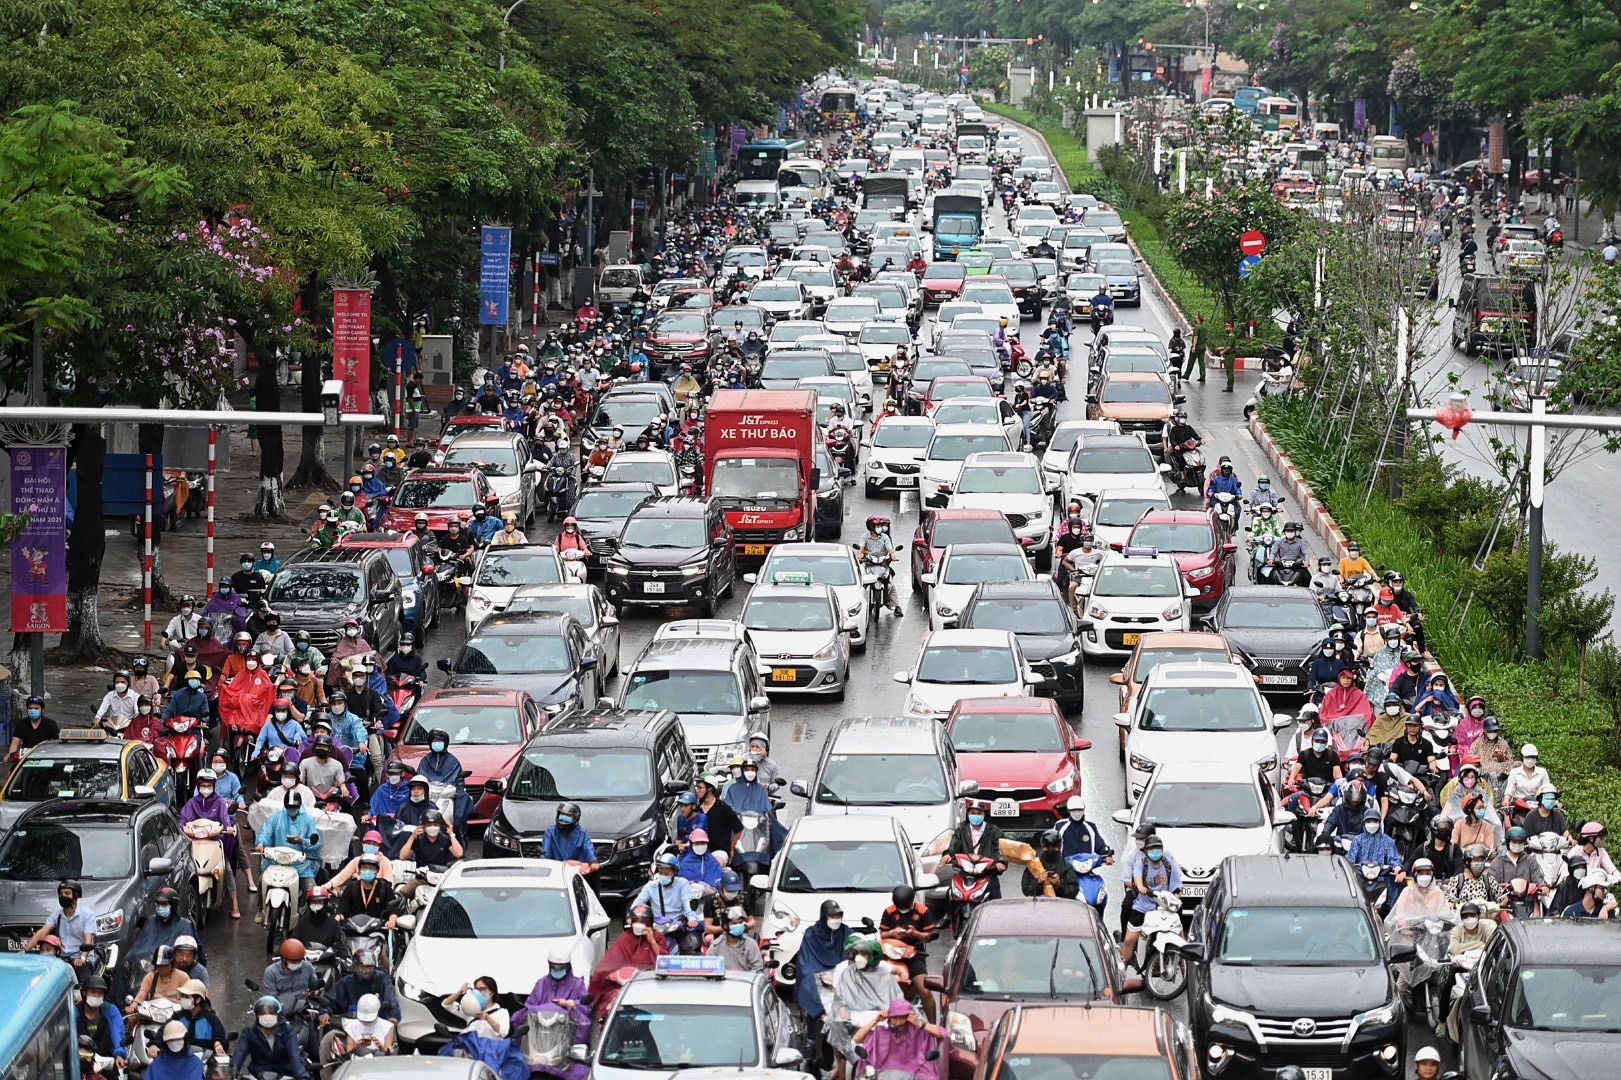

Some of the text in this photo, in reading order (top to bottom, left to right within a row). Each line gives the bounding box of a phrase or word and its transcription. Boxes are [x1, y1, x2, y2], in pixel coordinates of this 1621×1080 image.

[721, 427, 796, 439] XE THƯ BÁO
[681, 958, 700, 969] SÔNG
